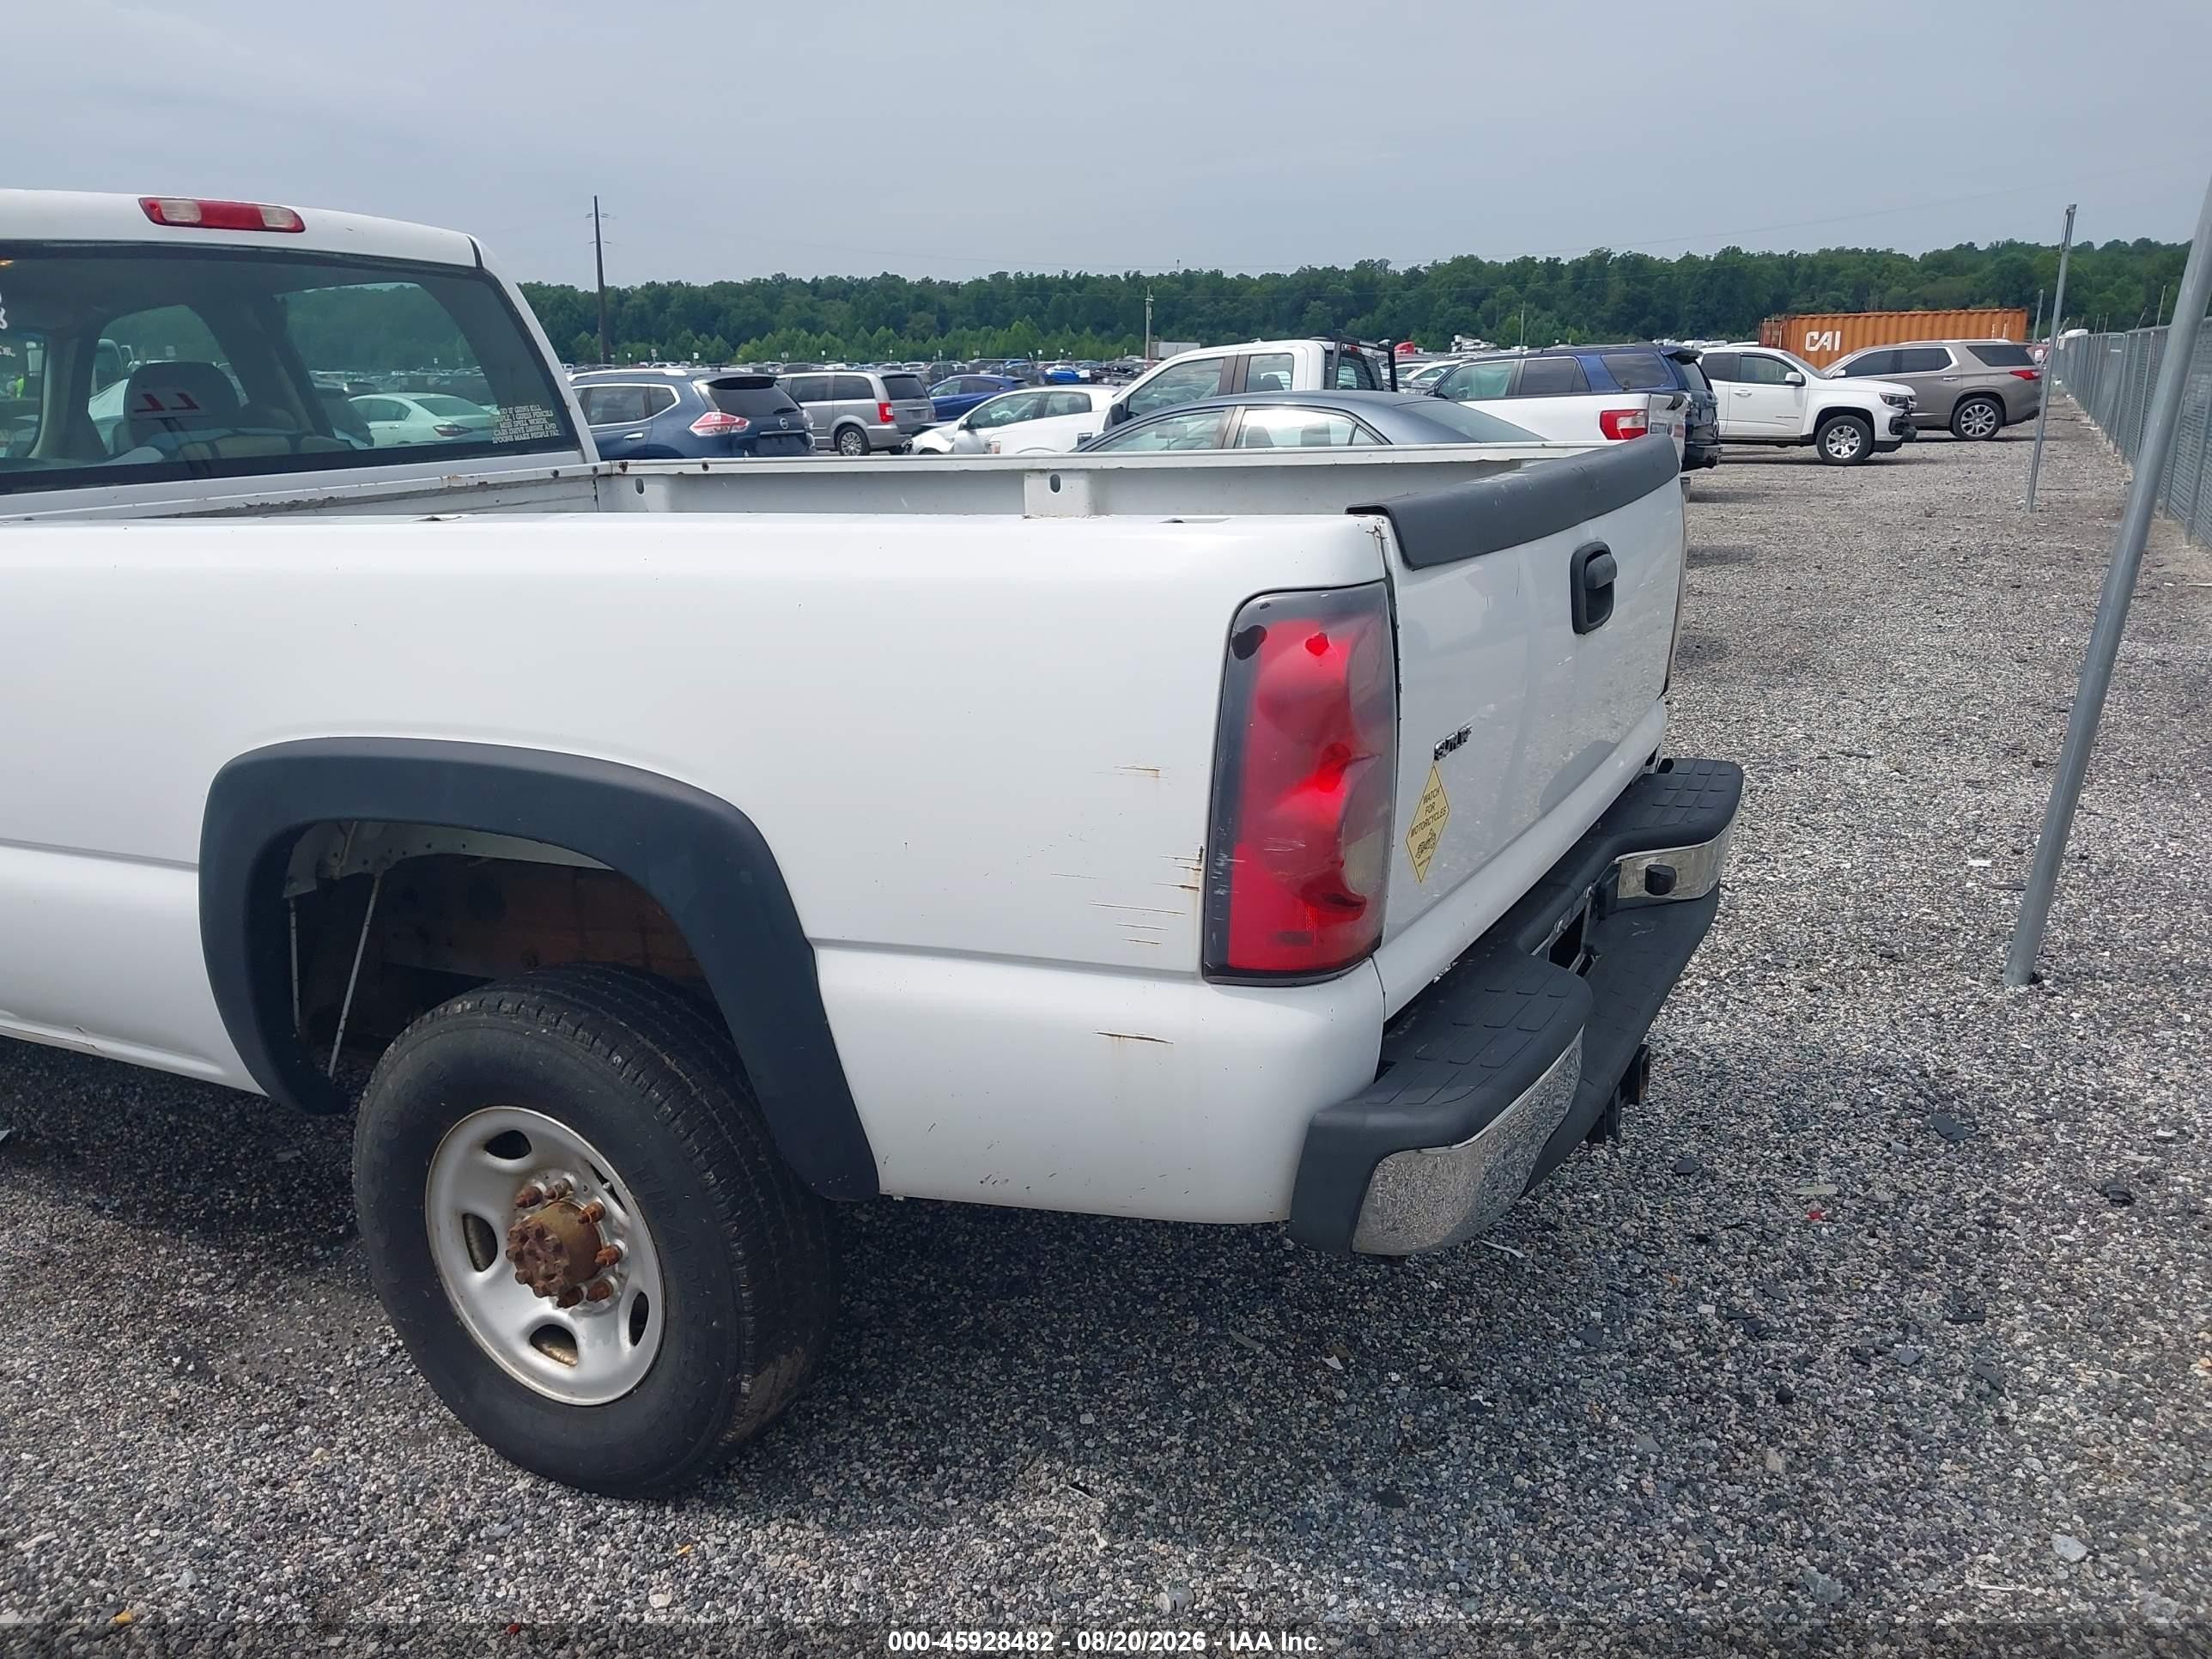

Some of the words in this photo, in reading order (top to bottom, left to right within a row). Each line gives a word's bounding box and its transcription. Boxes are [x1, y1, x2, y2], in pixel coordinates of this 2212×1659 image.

[1805, 331, 1841, 351] CAI
[1423, 787, 1440, 805] WATCH
[1425, 802, 1436, 816] FOR
[1411, 805, 1447, 838] MOTORCYCLES
